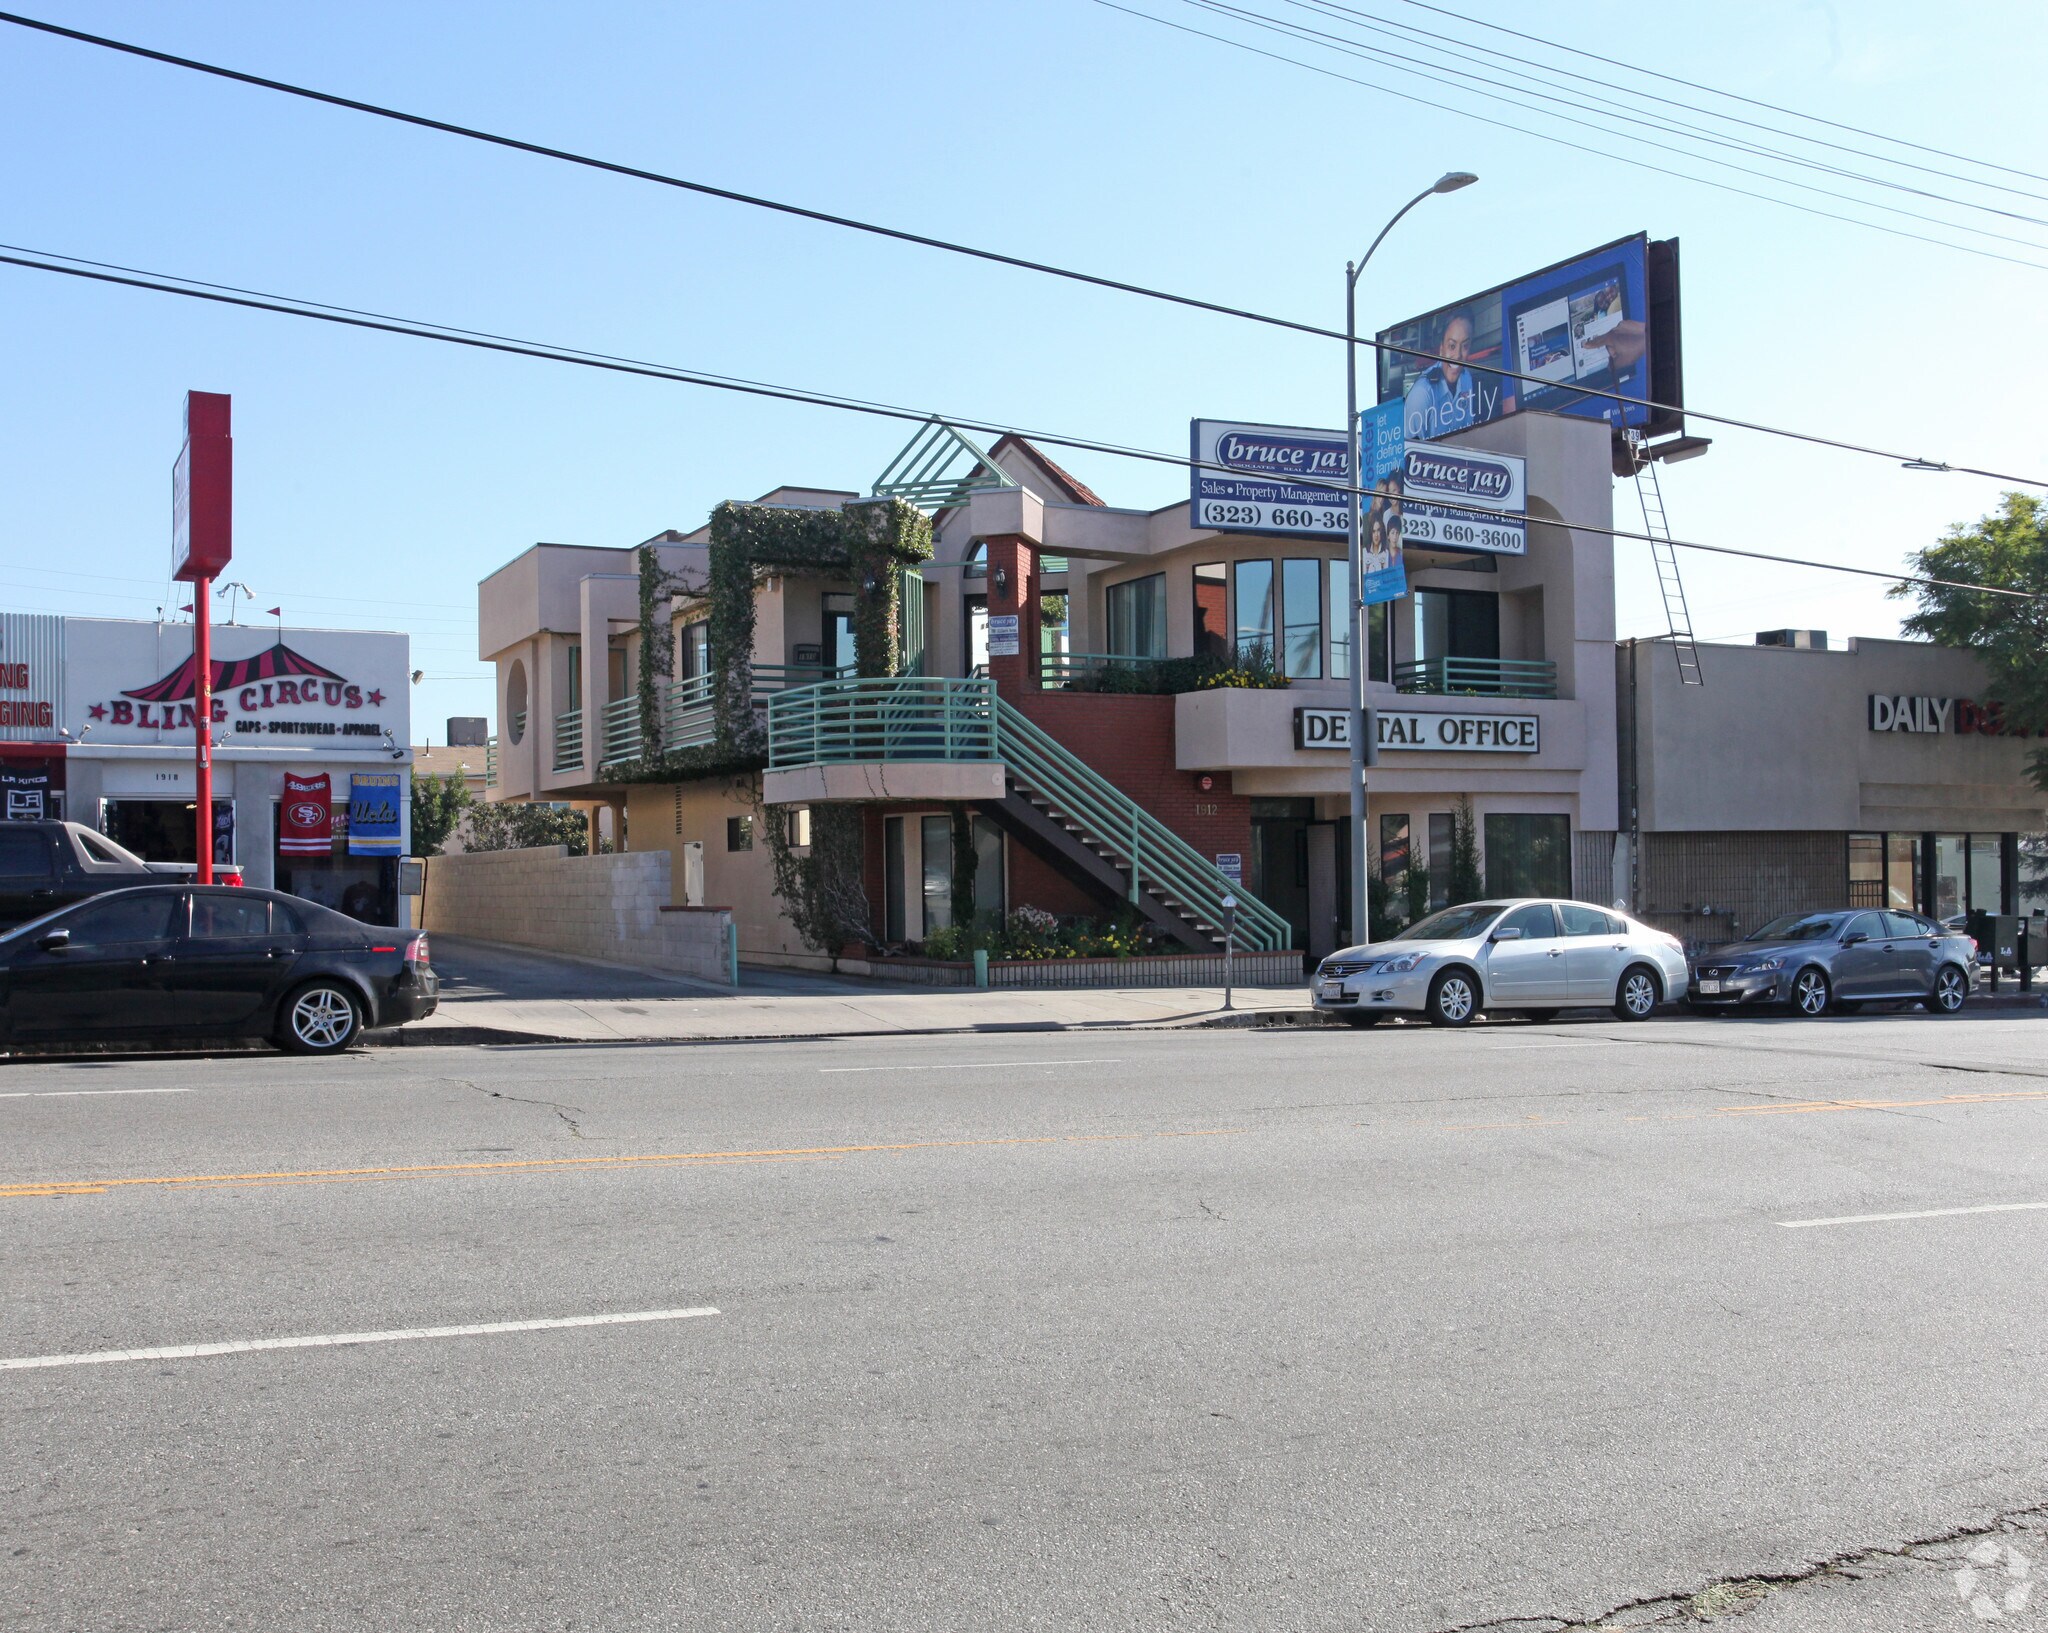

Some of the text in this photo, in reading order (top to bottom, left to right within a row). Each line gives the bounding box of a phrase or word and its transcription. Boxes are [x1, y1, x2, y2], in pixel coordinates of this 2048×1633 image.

[1404, 382, 1497, 436] onestly
[1377, 415, 1387, 427] let
[1377, 426, 1401, 446] love
[1227, 437, 1348, 475] bruce jay
[1377, 443, 1403, 460] define
[1408, 454, 1507, 495] bruce jay
[1201, 480, 1340, 503] Sales Property Management
[1204, 502, 1361, 530] (323) 660-36
[1402, 518, 1521, 549] 323) 660-3600
[111, 678, 363, 730] BLING CIRCUS
[1869, 694, 1953, 733] DAILY
[235, 720, 381, 736] CAPS SPORTSWEAR APPAREL
[1307, 715, 1535, 746] DETAL OFFICE
[2, 775, 47, 784] LA KINGS
[156, 773, 179, 781] 1918
[352, 775, 399, 787] BRUINS
[288, 781, 326, 792] 49ERS
[11, 795, 40, 807] LA
[1196, 804, 1218, 815] 1912
[298, 806, 318, 824] SF
[2001, 947, 2012, 955] LA
